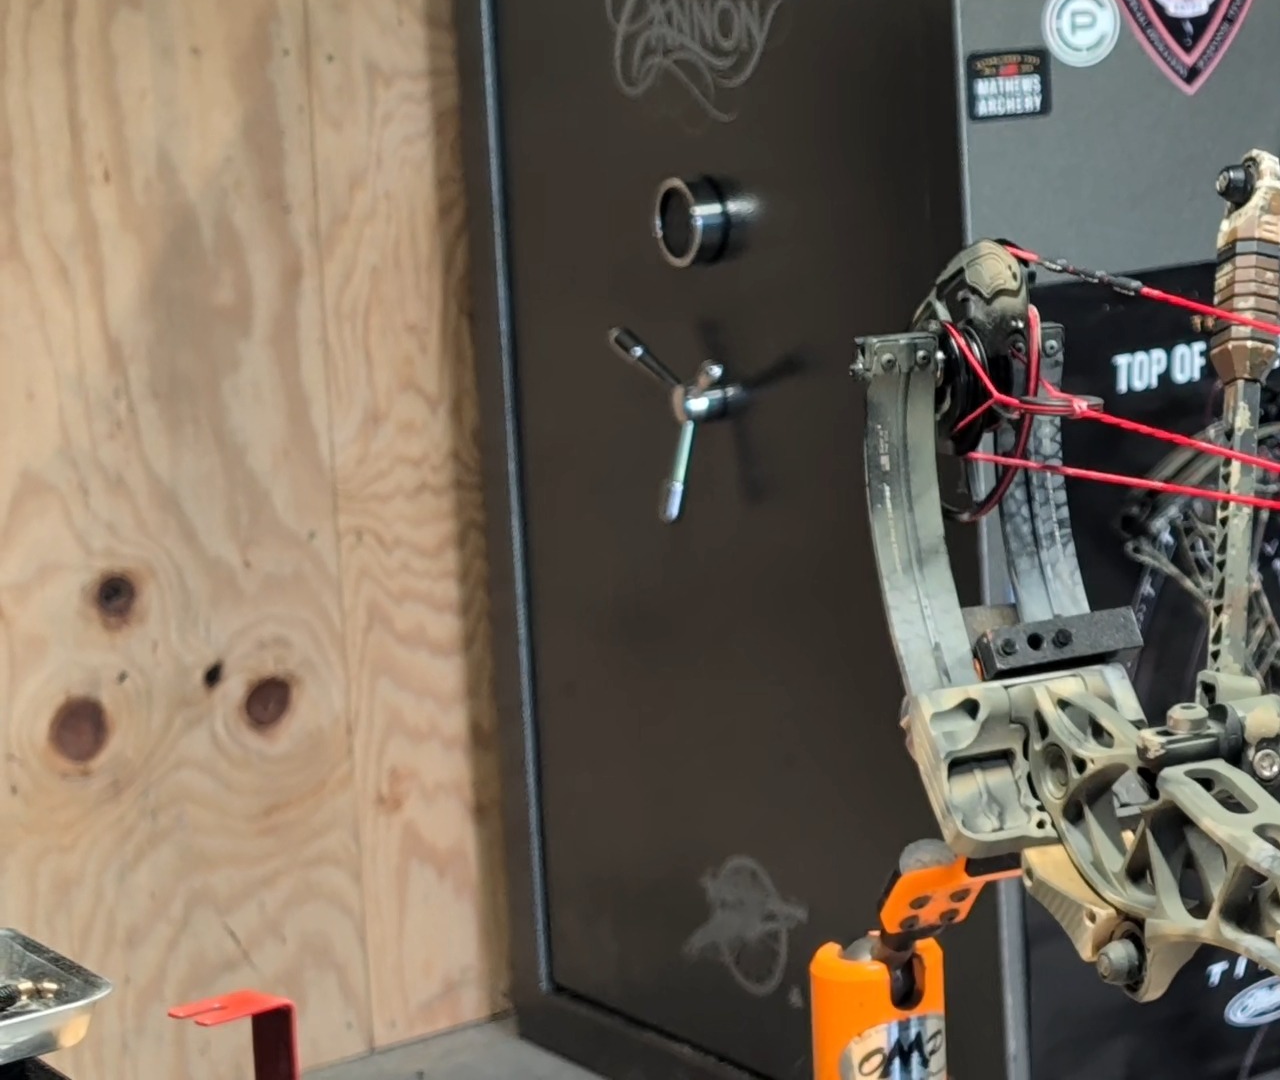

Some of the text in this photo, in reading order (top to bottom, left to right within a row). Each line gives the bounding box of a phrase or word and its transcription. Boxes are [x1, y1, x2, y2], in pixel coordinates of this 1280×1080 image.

[973, 74, 1042, 98] MATHEWS
[975, 95, 1042, 118] ARCHERY
[1111, 348, 1168, 395] TOP
[1170, 340, 1207, 385] OF
